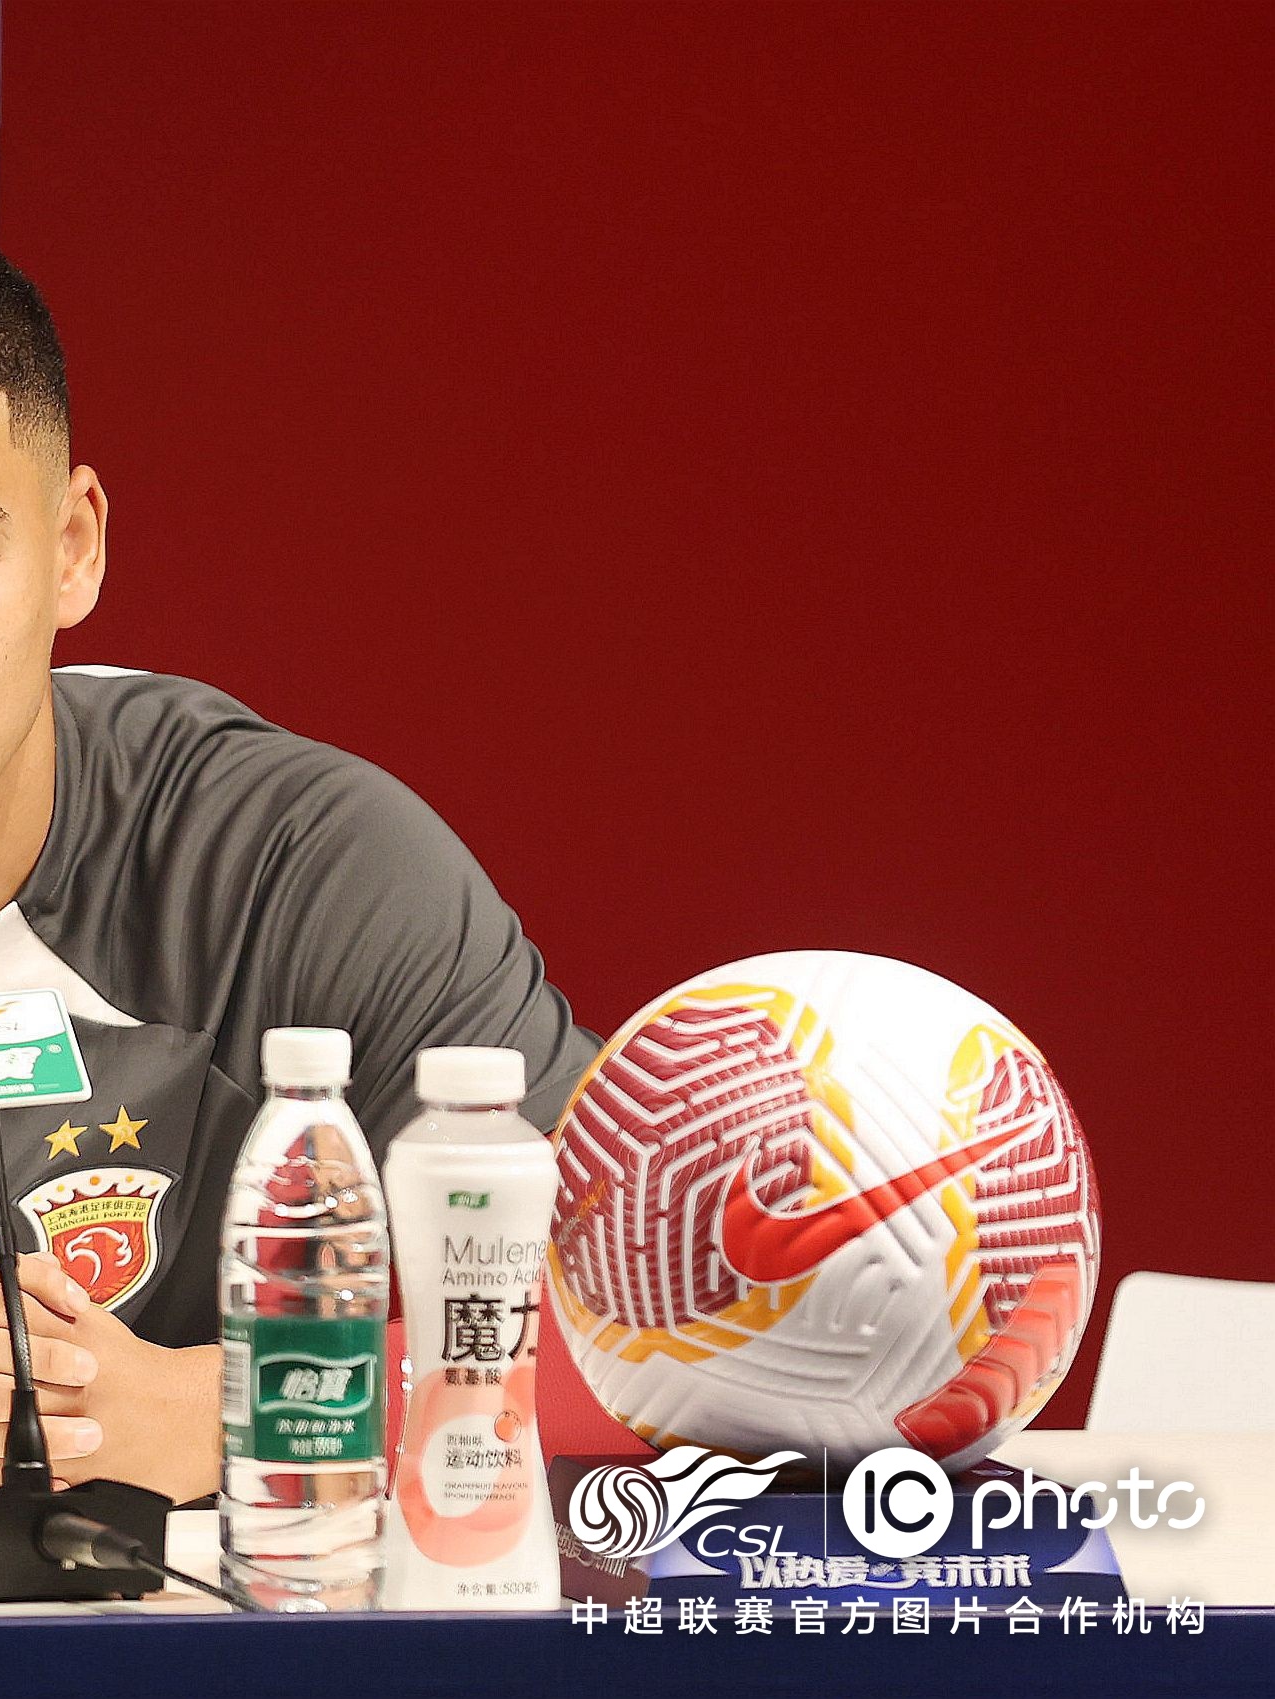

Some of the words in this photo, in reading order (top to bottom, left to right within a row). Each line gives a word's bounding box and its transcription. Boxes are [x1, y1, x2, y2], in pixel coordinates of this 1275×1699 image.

[49, 1213, 99, 1232] SHANGHAI
[443, 1267, 508, 1286] Amino
[445, 1448, 523, 1469] 运动饮料
